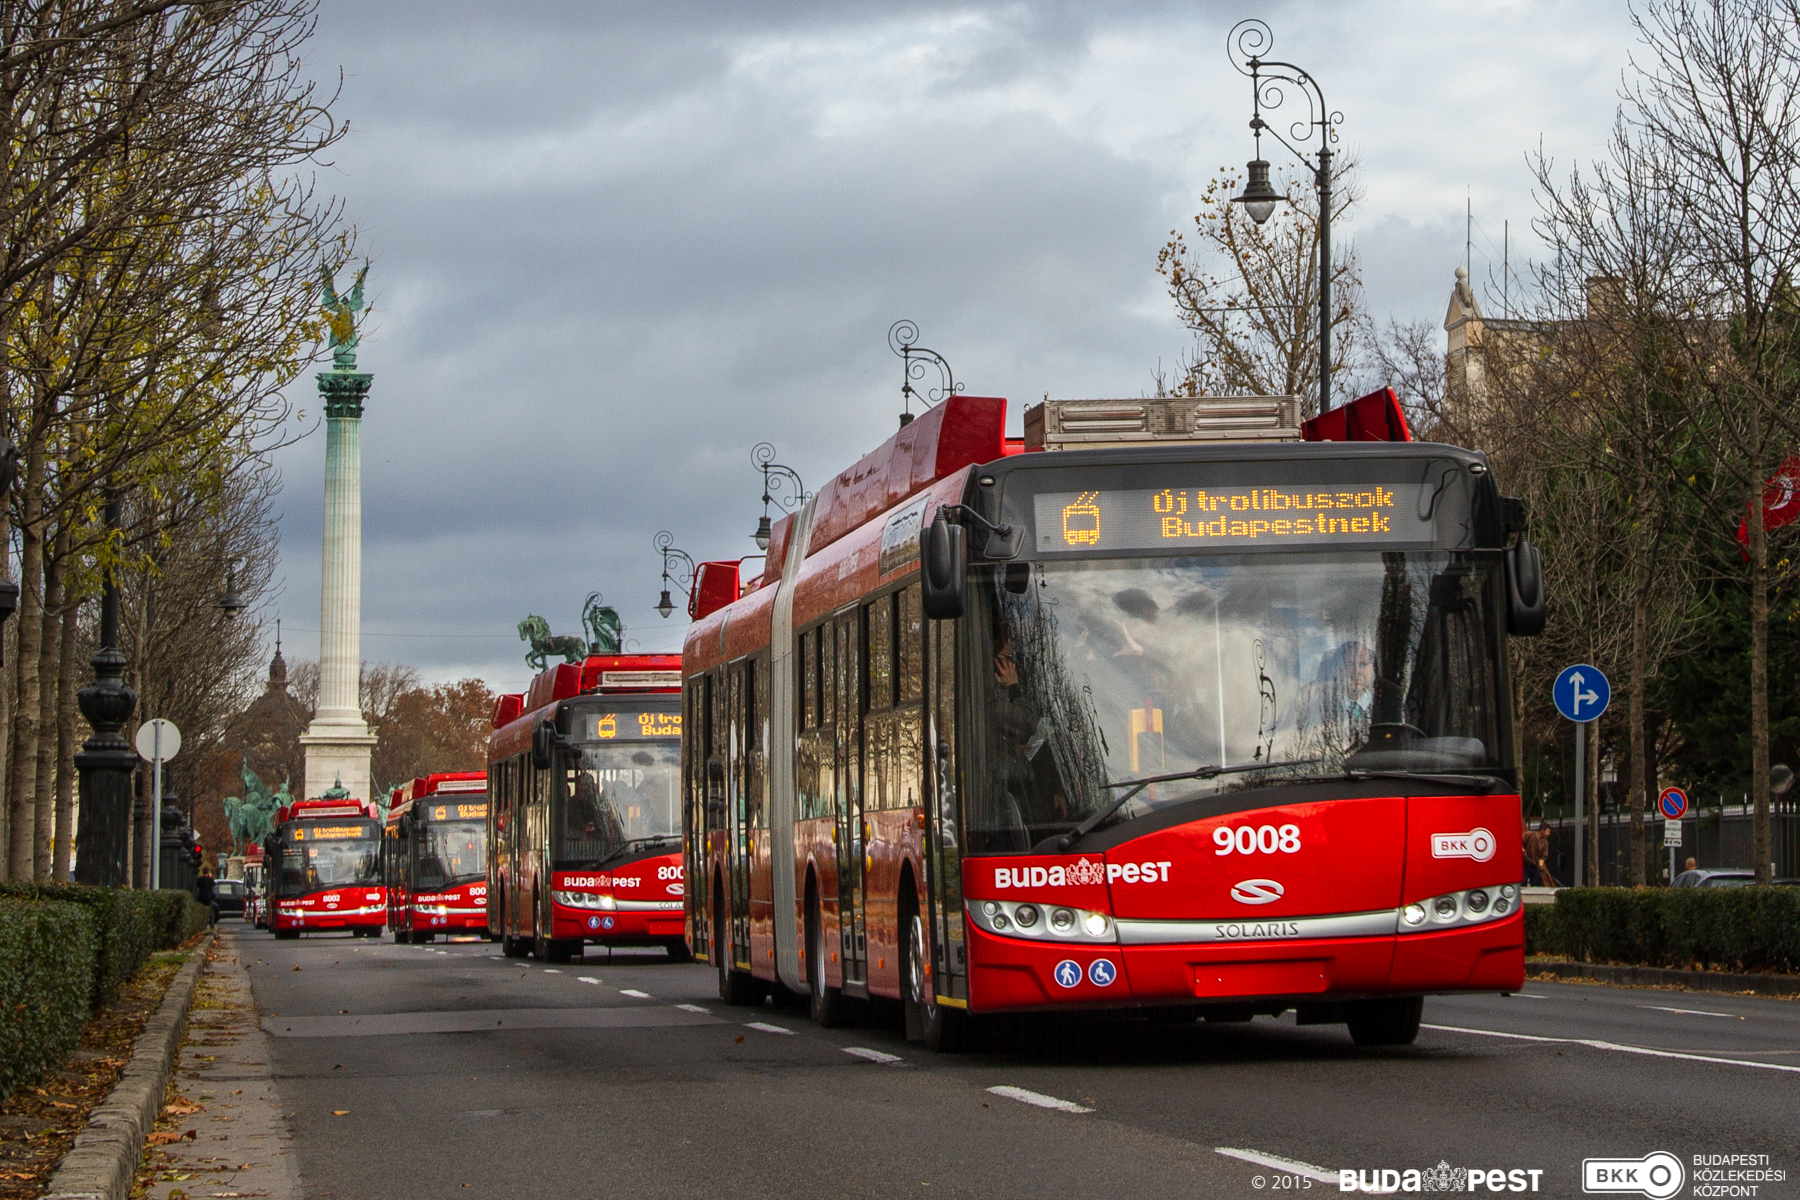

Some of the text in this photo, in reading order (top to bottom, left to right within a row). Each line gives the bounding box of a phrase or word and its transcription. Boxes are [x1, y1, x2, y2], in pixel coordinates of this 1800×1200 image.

[1153, 486, 1394, 515] Új trolibuszok
[1161, 511, 1390, 538] Budapestnek
[638, 712, 683, 726] Új tro
[642, 724, 682, 736] Buda
[1212, 824, 1301, 856] 9008
[1441, 840, 1468, 851] BKK
[322, 894, 341, 903] 8002
[659, 902, 684, 910] SOLA
[1215, 922, 1300, 940] SOLARIS
